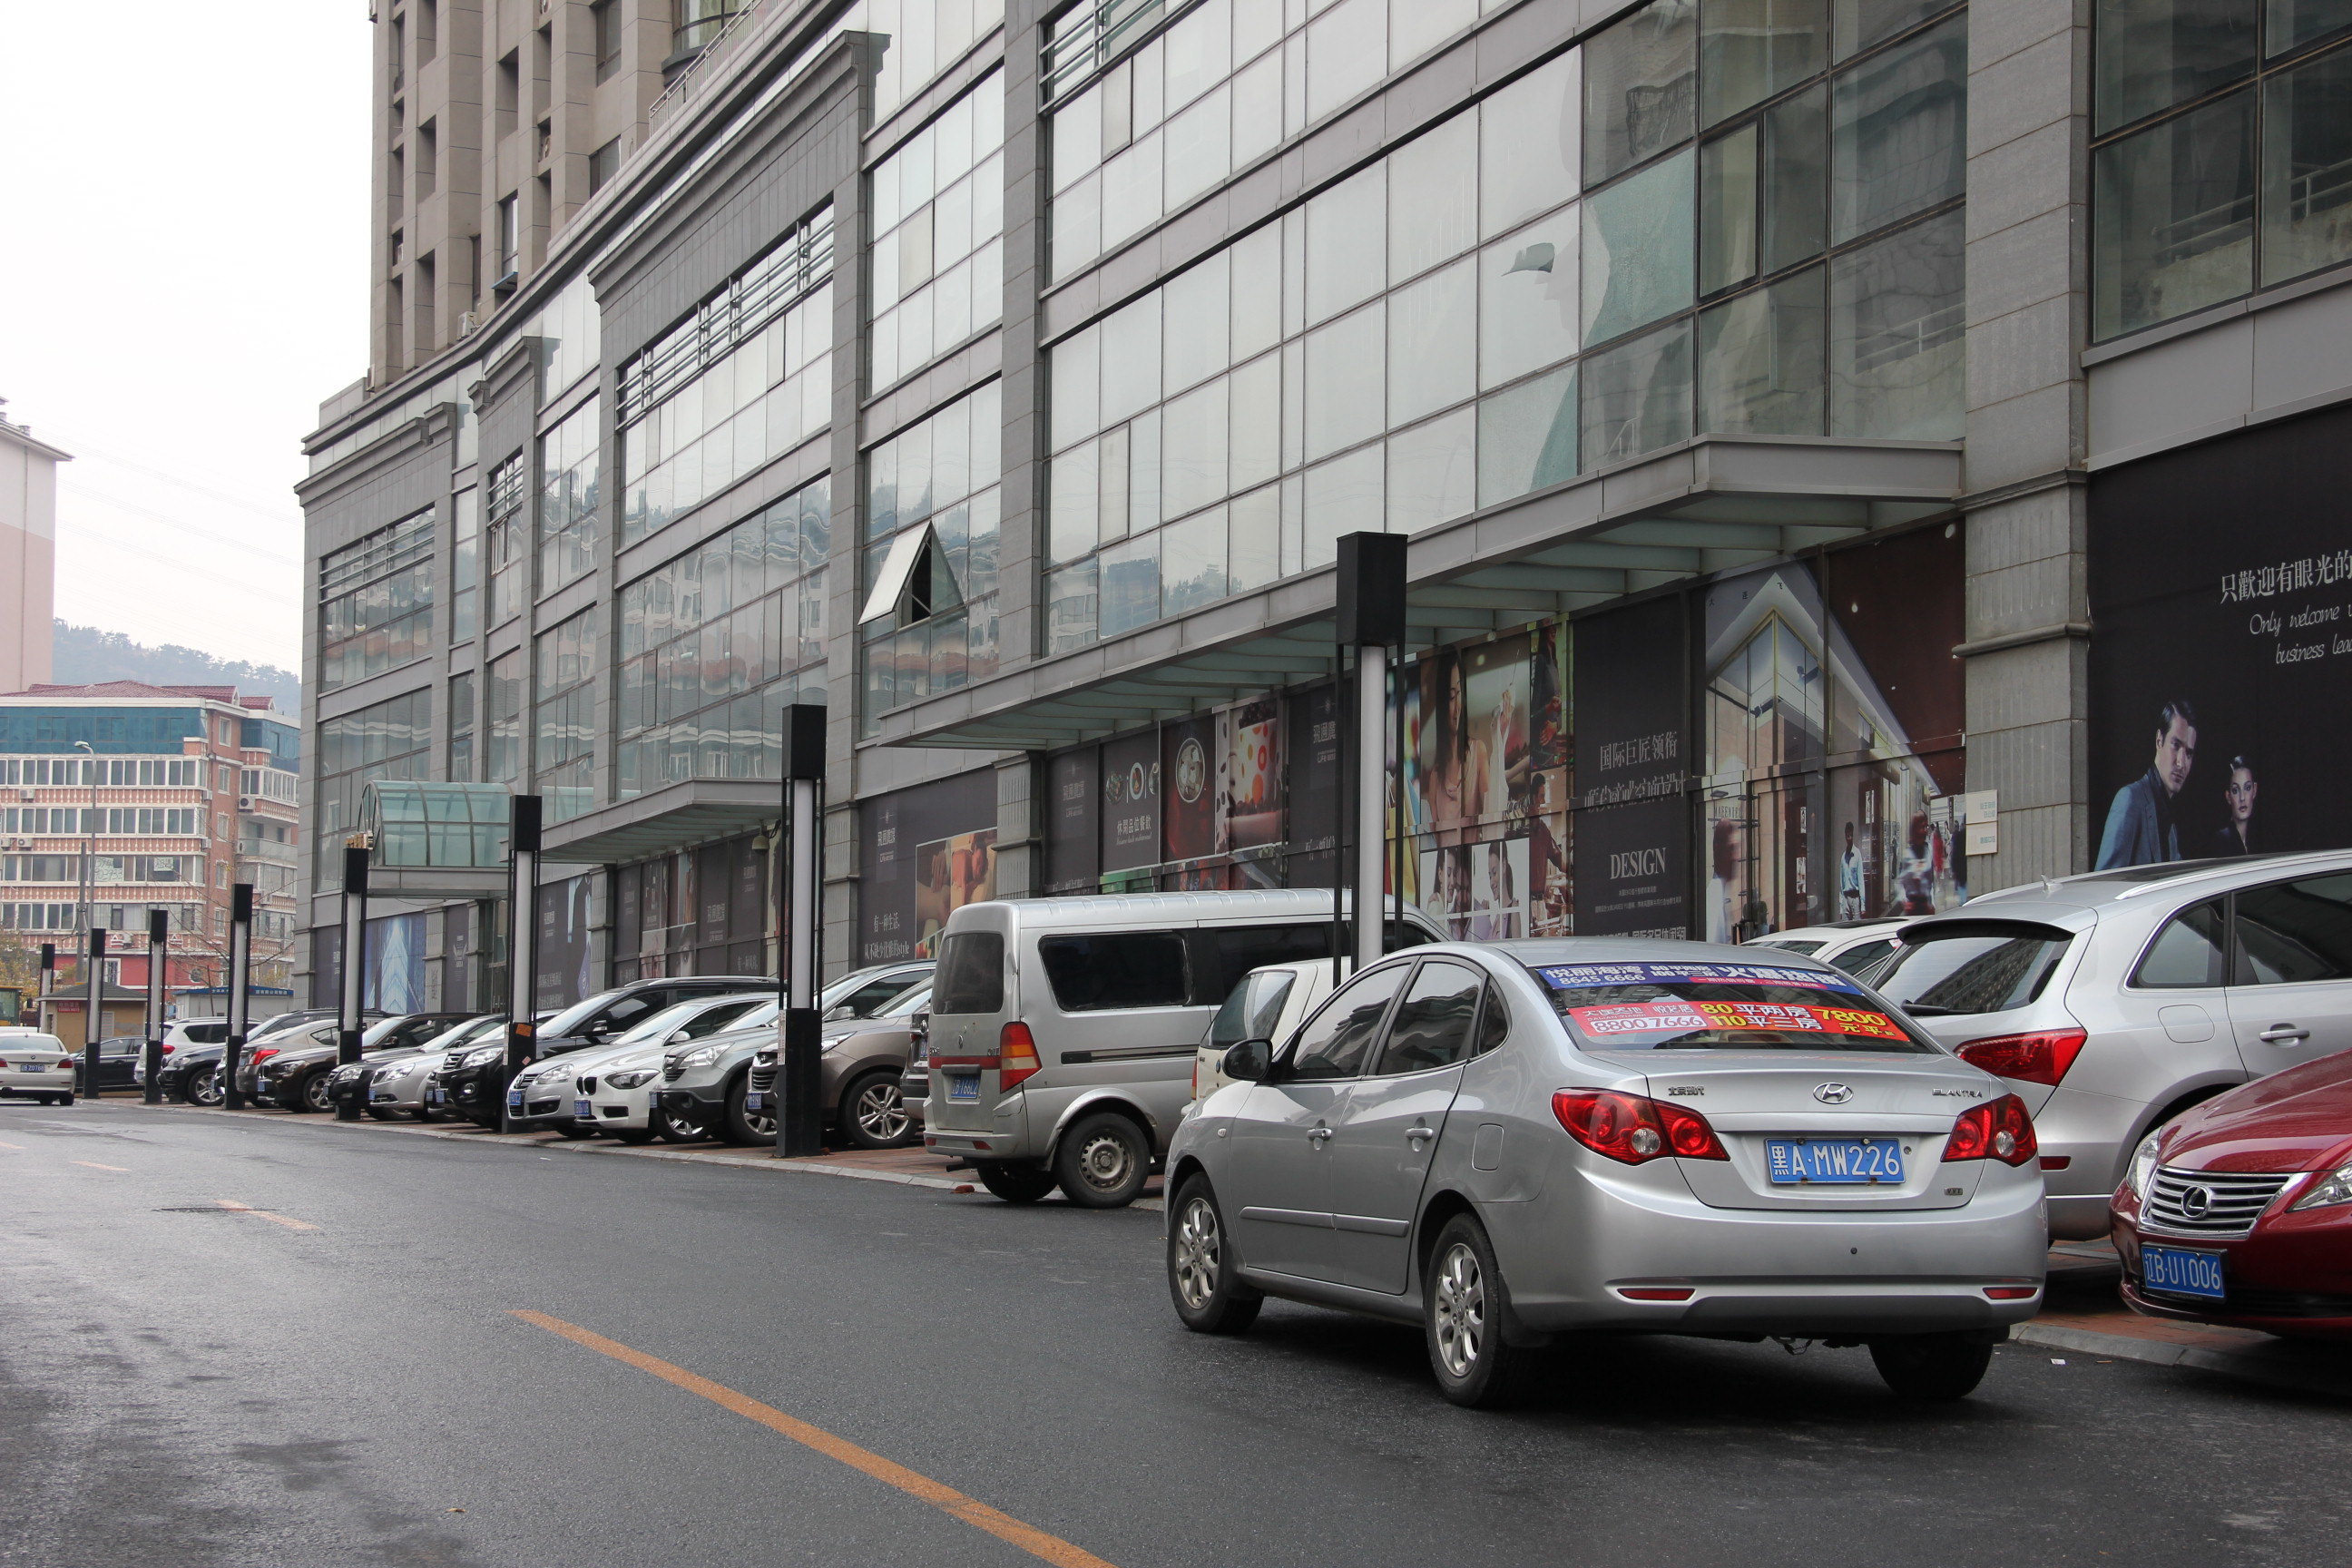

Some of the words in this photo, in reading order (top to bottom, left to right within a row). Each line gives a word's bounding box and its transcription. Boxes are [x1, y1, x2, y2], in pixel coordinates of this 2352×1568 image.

[2249, 611, 2281, 637] Only
[2289, 604, 2340, 628] welcome
[2276, 643, 2325, 664] business
[1600, 731, 1678, 771] 国际巨匠领衔
[1610, 848, 1667, 879] DESIGN
[1560, 975, 1602, 985] 8645
[1604, 974, 1646, 982] 6666
[1717, 965, 1847, 986] 火爆热销
[1700, 1003, 1812, 1018] 80平两房
[1812, 1008, 1887, 1026] 7800
[1594, 1019, 1647, 1032] 8800
[1649, 1016, 1703, 1028] 7666
[1708, 1015, 1823, 1030] 110平三房
[1932, 1088, 1983, 1098] ELANTRA
